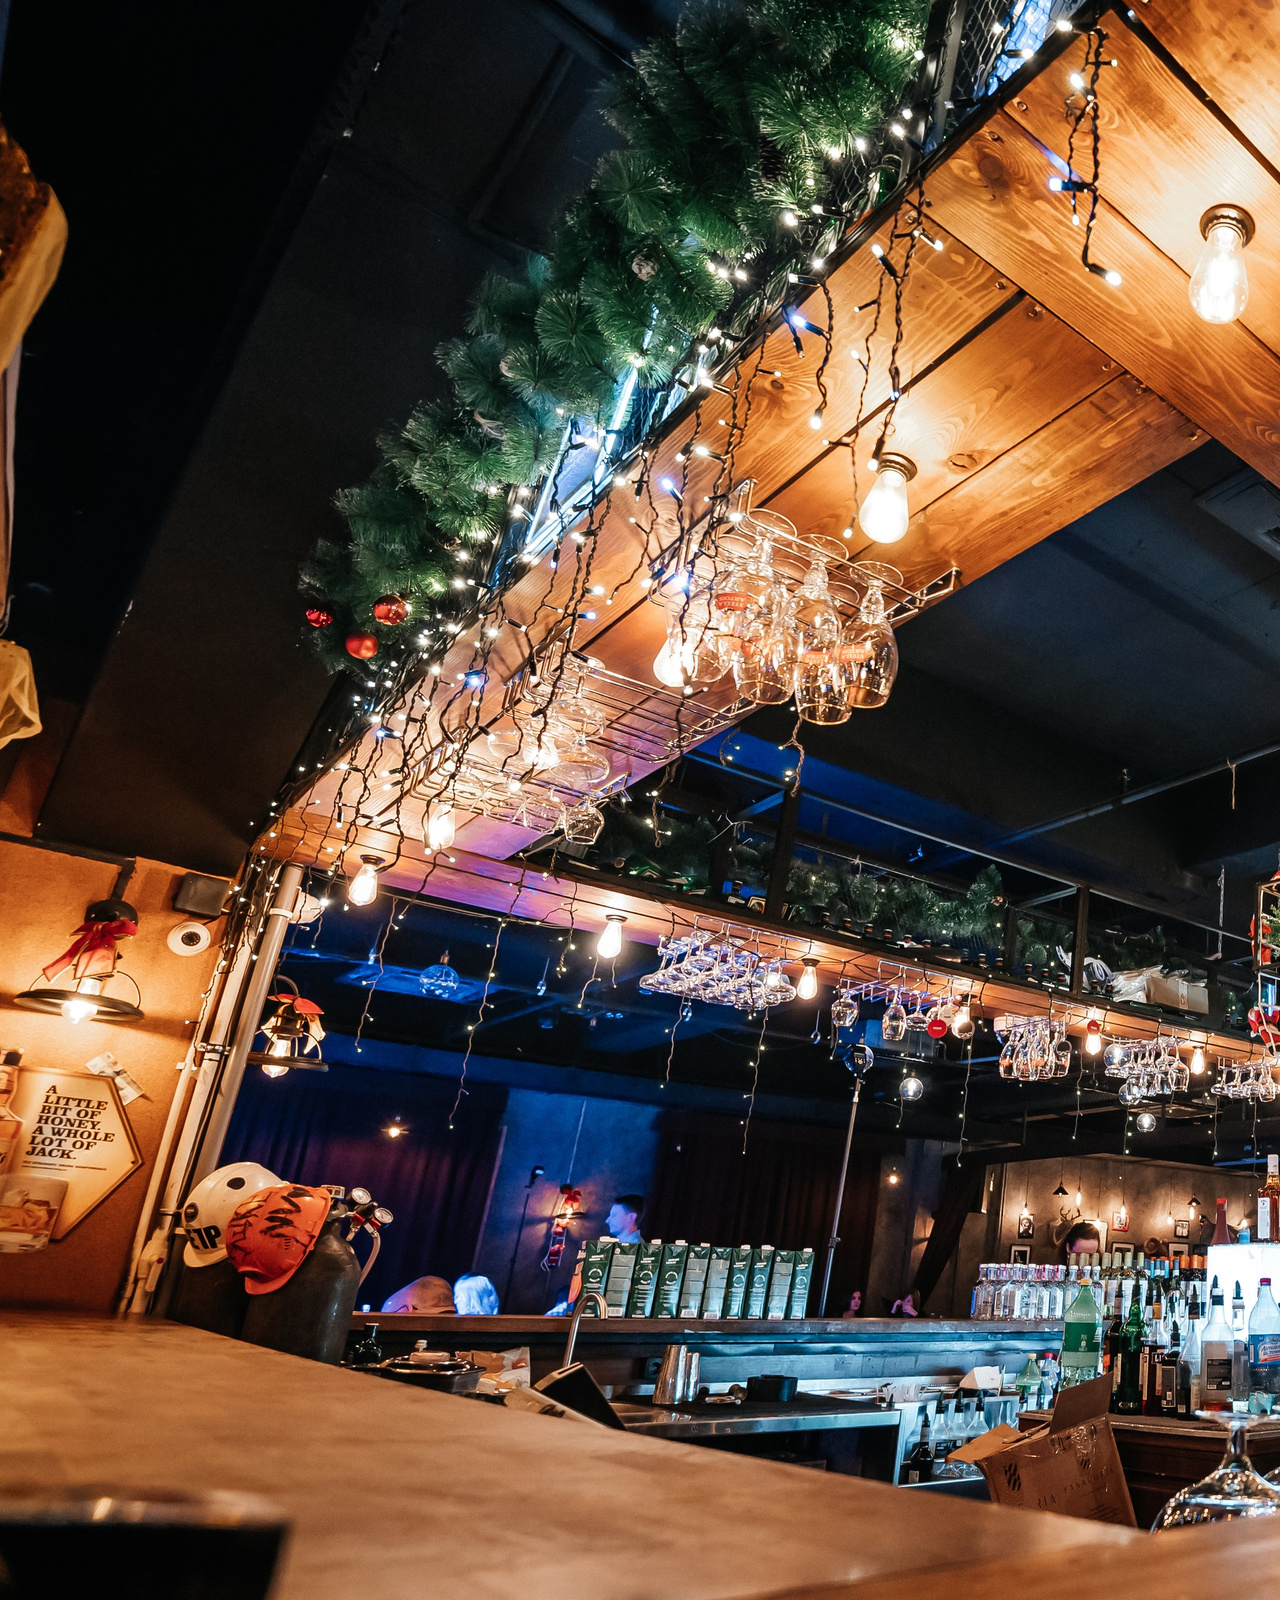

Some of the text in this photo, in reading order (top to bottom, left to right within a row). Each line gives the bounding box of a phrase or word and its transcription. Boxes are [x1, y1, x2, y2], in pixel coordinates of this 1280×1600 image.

[45, 1084, 58, 1095] A
[43, 1094, 108, 1111] LITTLE
[39, 1104, 102, 1119] BIT OF
[36, 1115, 101, 1131] HONEY.
[32, 1125, 115, 1143] A WHOLE
[29, 1135, 97, 1150] LOT OF
[25, 1146, 77, 1160] JACK.
